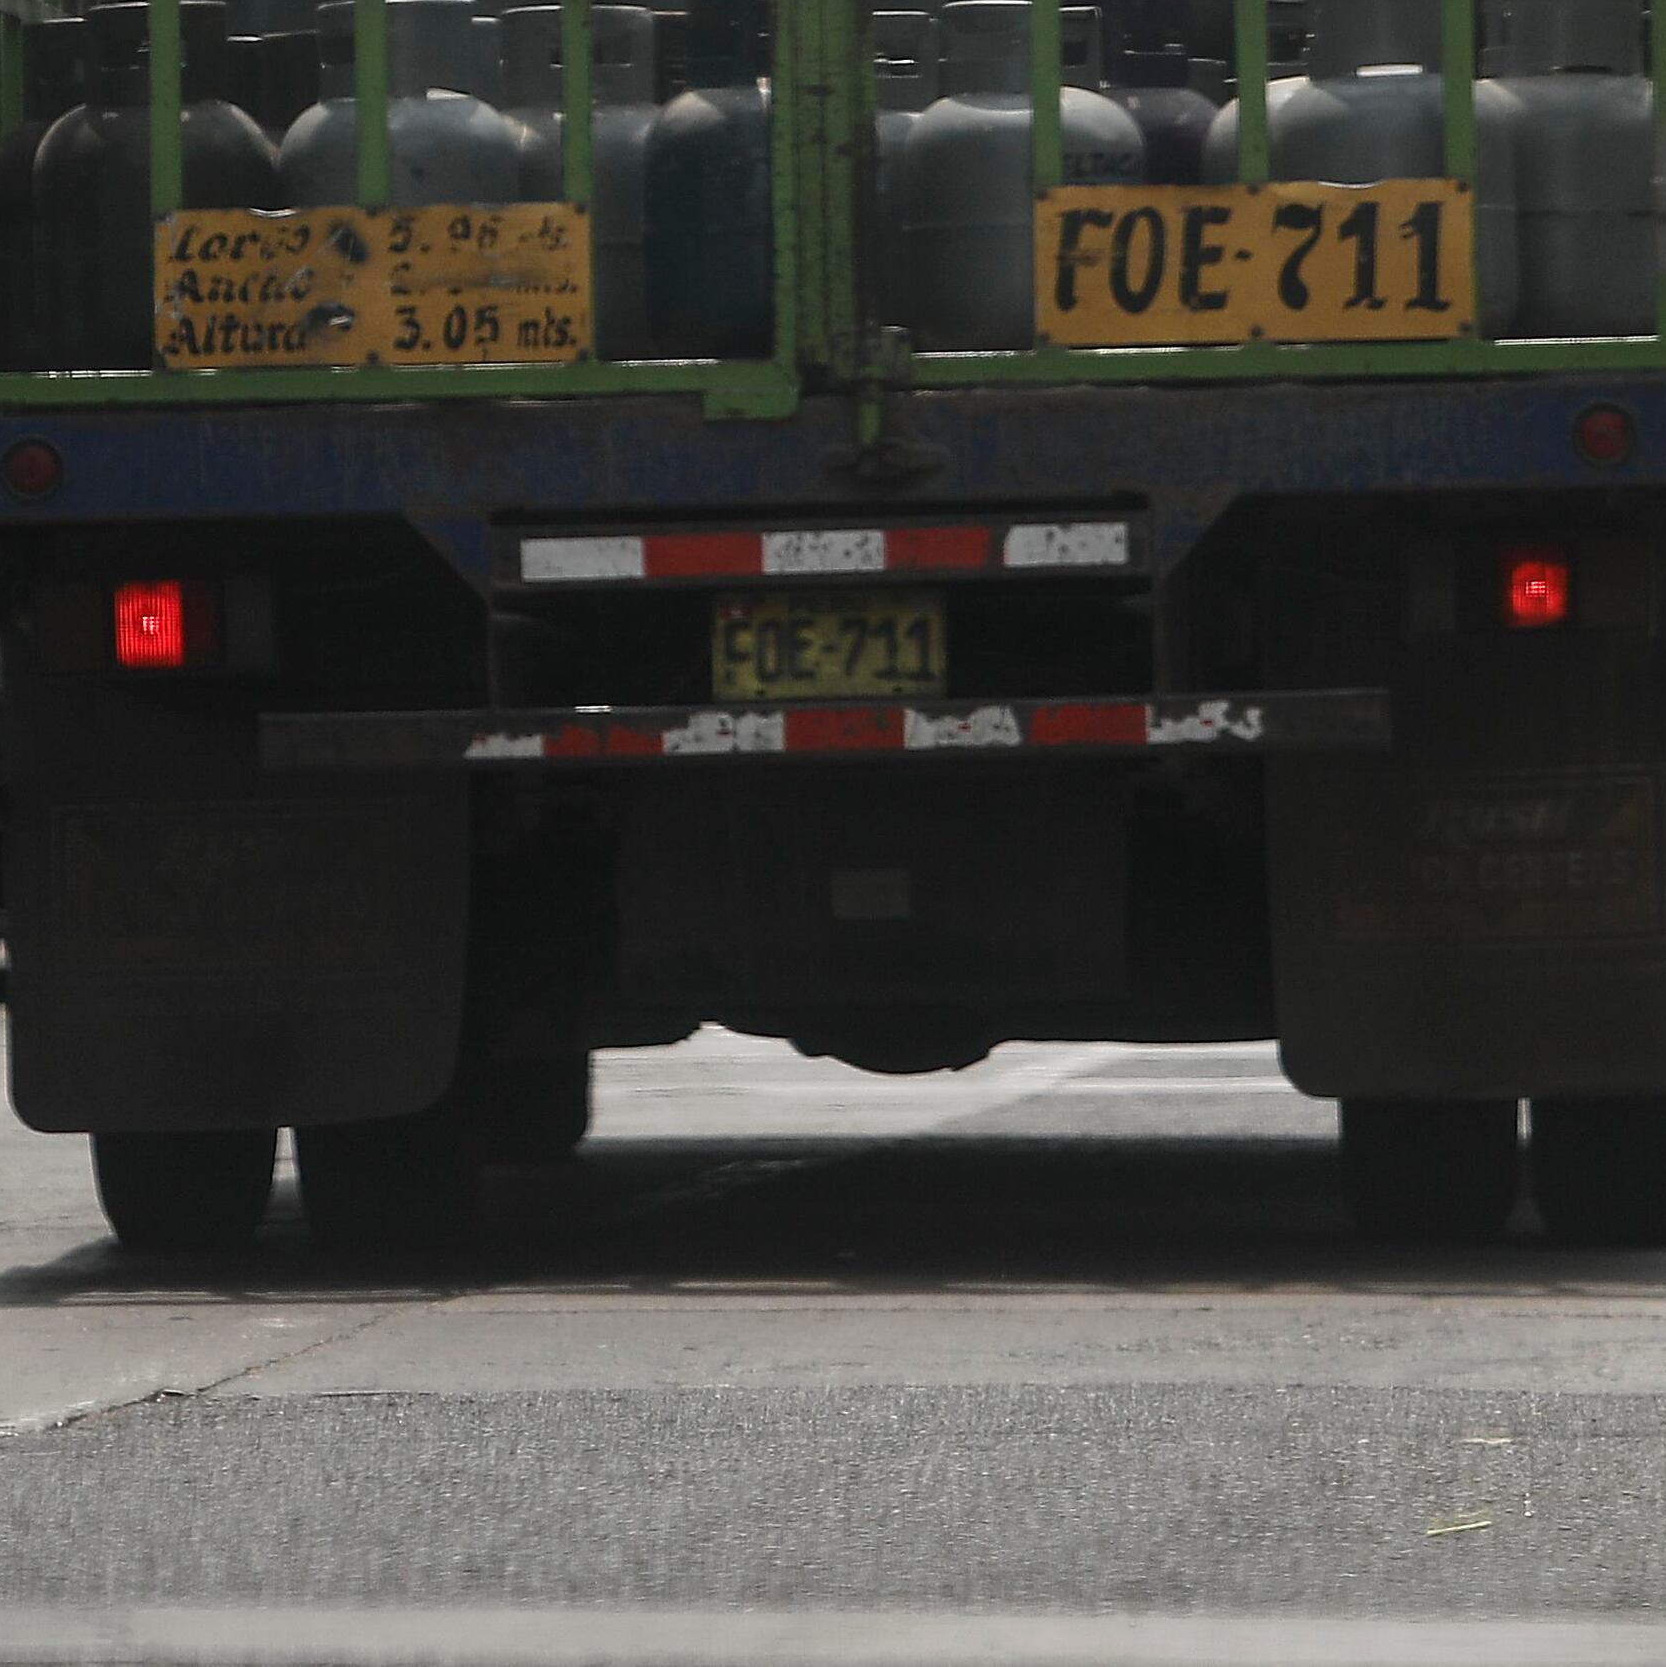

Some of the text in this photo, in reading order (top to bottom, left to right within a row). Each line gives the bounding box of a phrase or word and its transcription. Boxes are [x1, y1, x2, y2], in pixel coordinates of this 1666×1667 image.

[1053, 200, 1453, 314] FOE-711
[392, 303, 500, 351] 3.05
[722, 617, 938, 683] FOE-711
